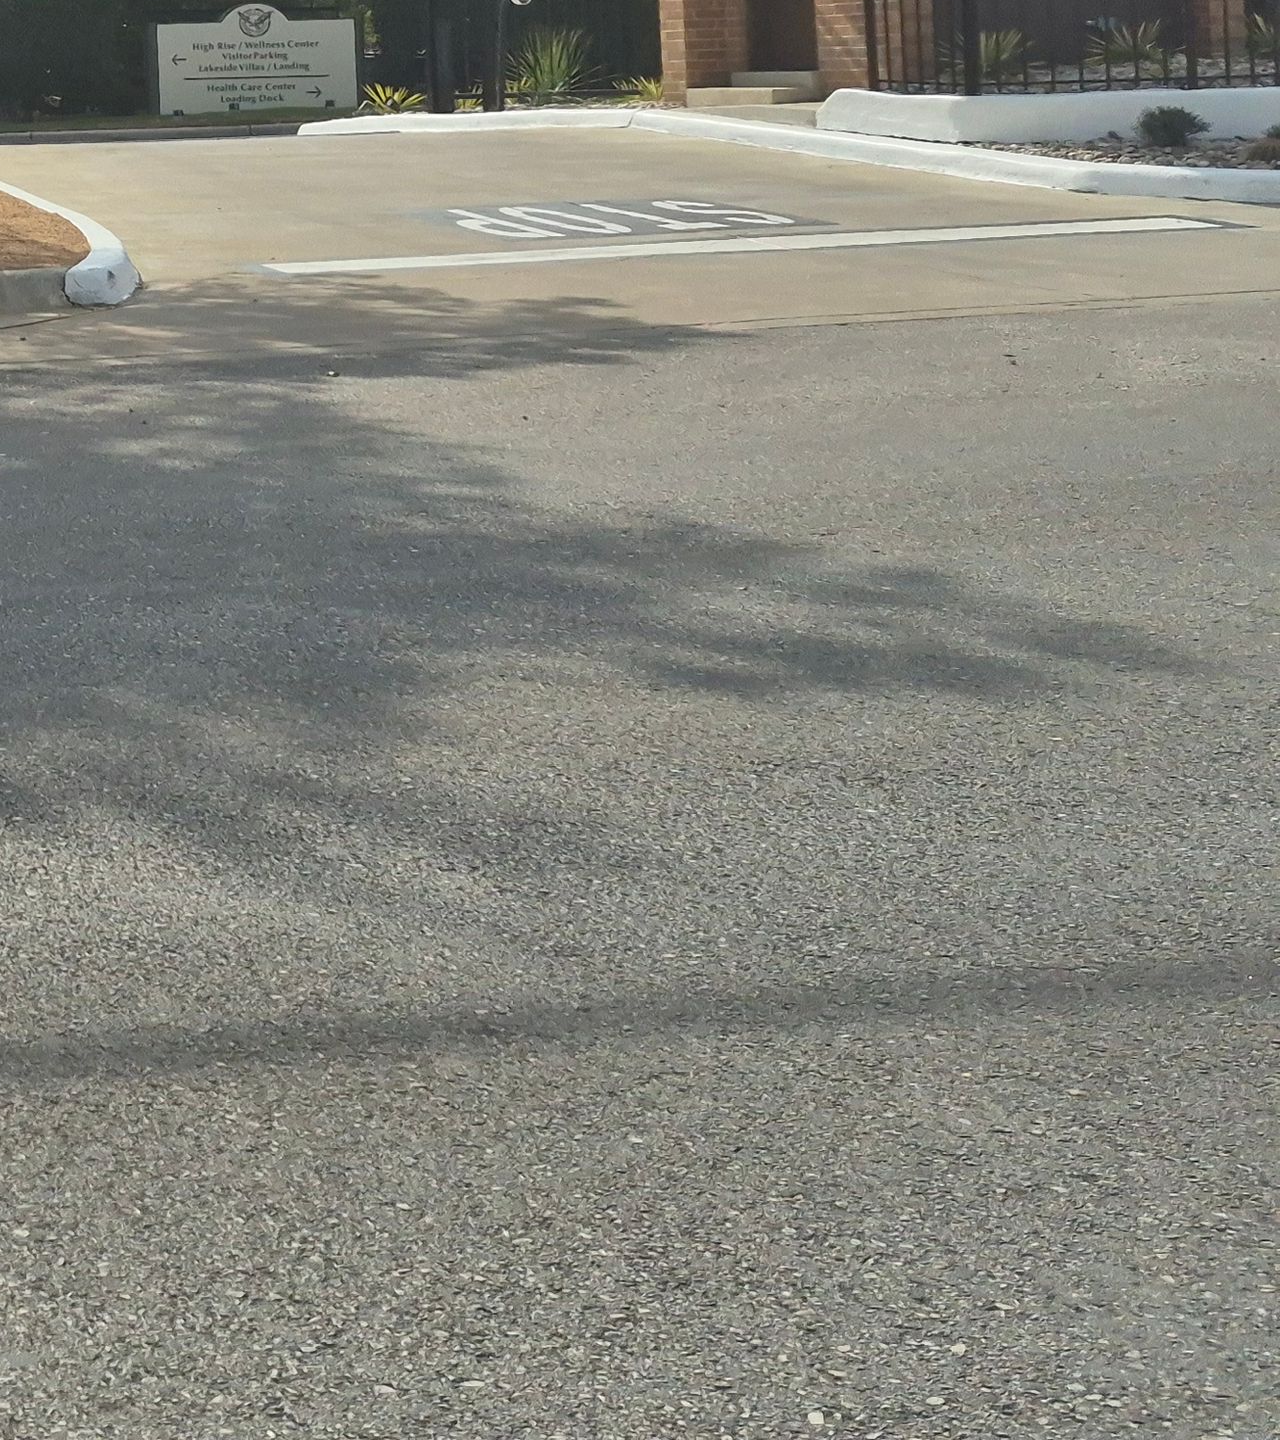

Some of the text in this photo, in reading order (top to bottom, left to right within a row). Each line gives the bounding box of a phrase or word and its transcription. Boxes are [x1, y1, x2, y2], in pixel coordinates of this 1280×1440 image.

[192, 43, 215, 53] High
[217, 42, 237, 50] Rise
[244, 41, 286, 50] Wellness
[287, 40, 320, 48] Center
[222, 51, 289, 61] Visitor Parking
[198, 64, 237, 73] Lakeside
[238, 63, 265, 71] Villas
[273, 62, 310, 72] Landing
[207, 82, 297, 92] Health Care Center
[220, 93, 285, 104] Loading Dock
[447, 200, 795, 237] STOP
